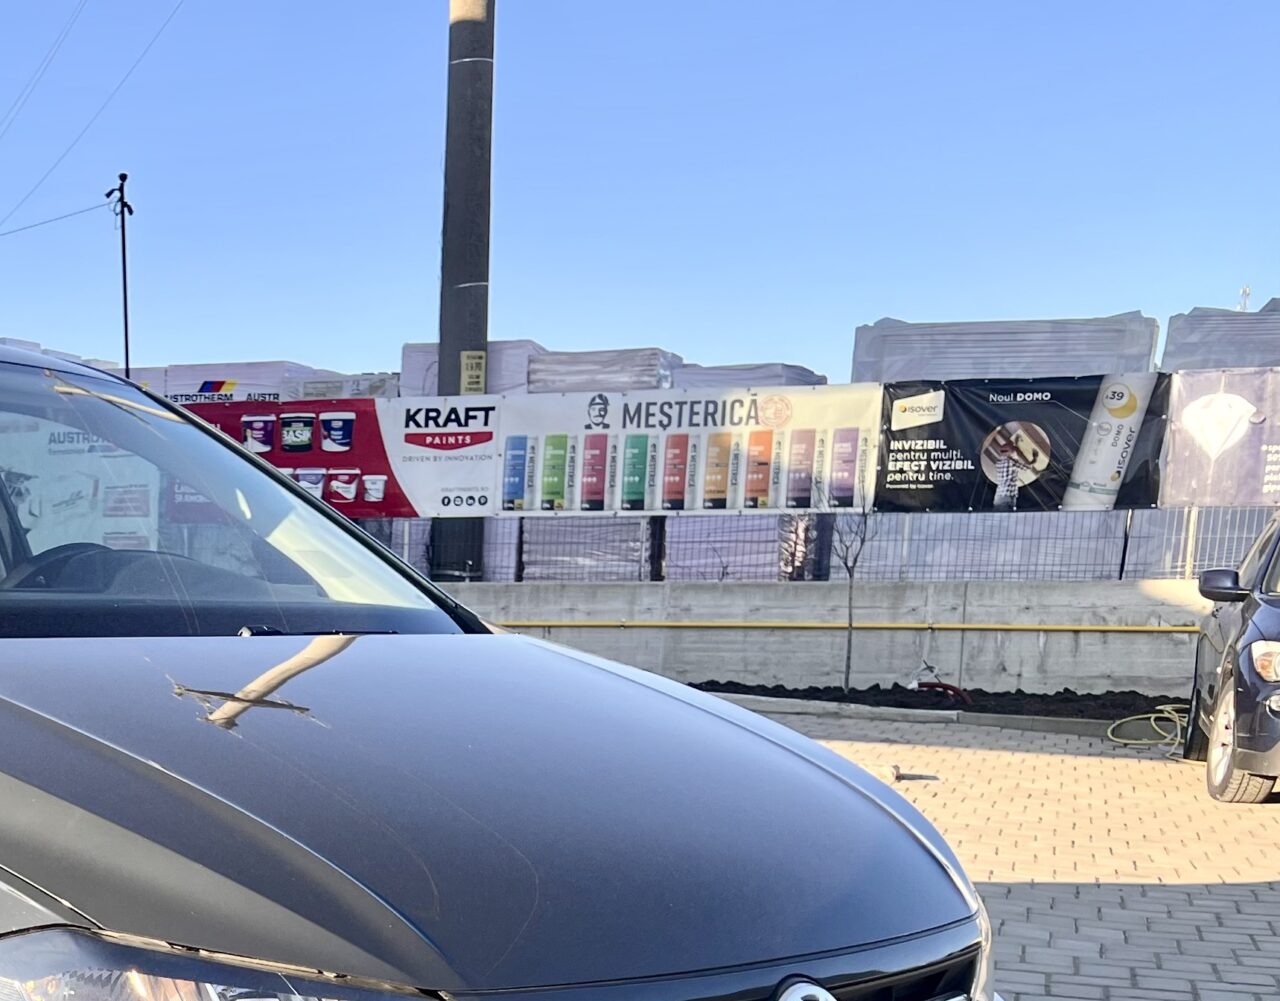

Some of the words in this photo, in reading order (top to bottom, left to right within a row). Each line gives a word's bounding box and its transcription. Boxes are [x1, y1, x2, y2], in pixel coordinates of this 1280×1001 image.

[988, 392, 1014, 402] Noul
[1015, 391, 1052, 402] DOMO
[404, 406, 496, 429] KRAFT
[425, 435, 472, 445] PAINTS
[1111, 423, 1125, 448] DOMO
[889, 439, 948, 451] INVIZIBIL
[402, 455, 431, 463] DRIVEN
[433, 455, 443, 463] BY
[444, 454, 493, 463] INNOVATION
[888, 450, 928, 462] pentru
[887, 460, 928, 471] EFECT
[930, 459, 976, 470] VIZIBIL
[886, 471, 926, 482] pentru
